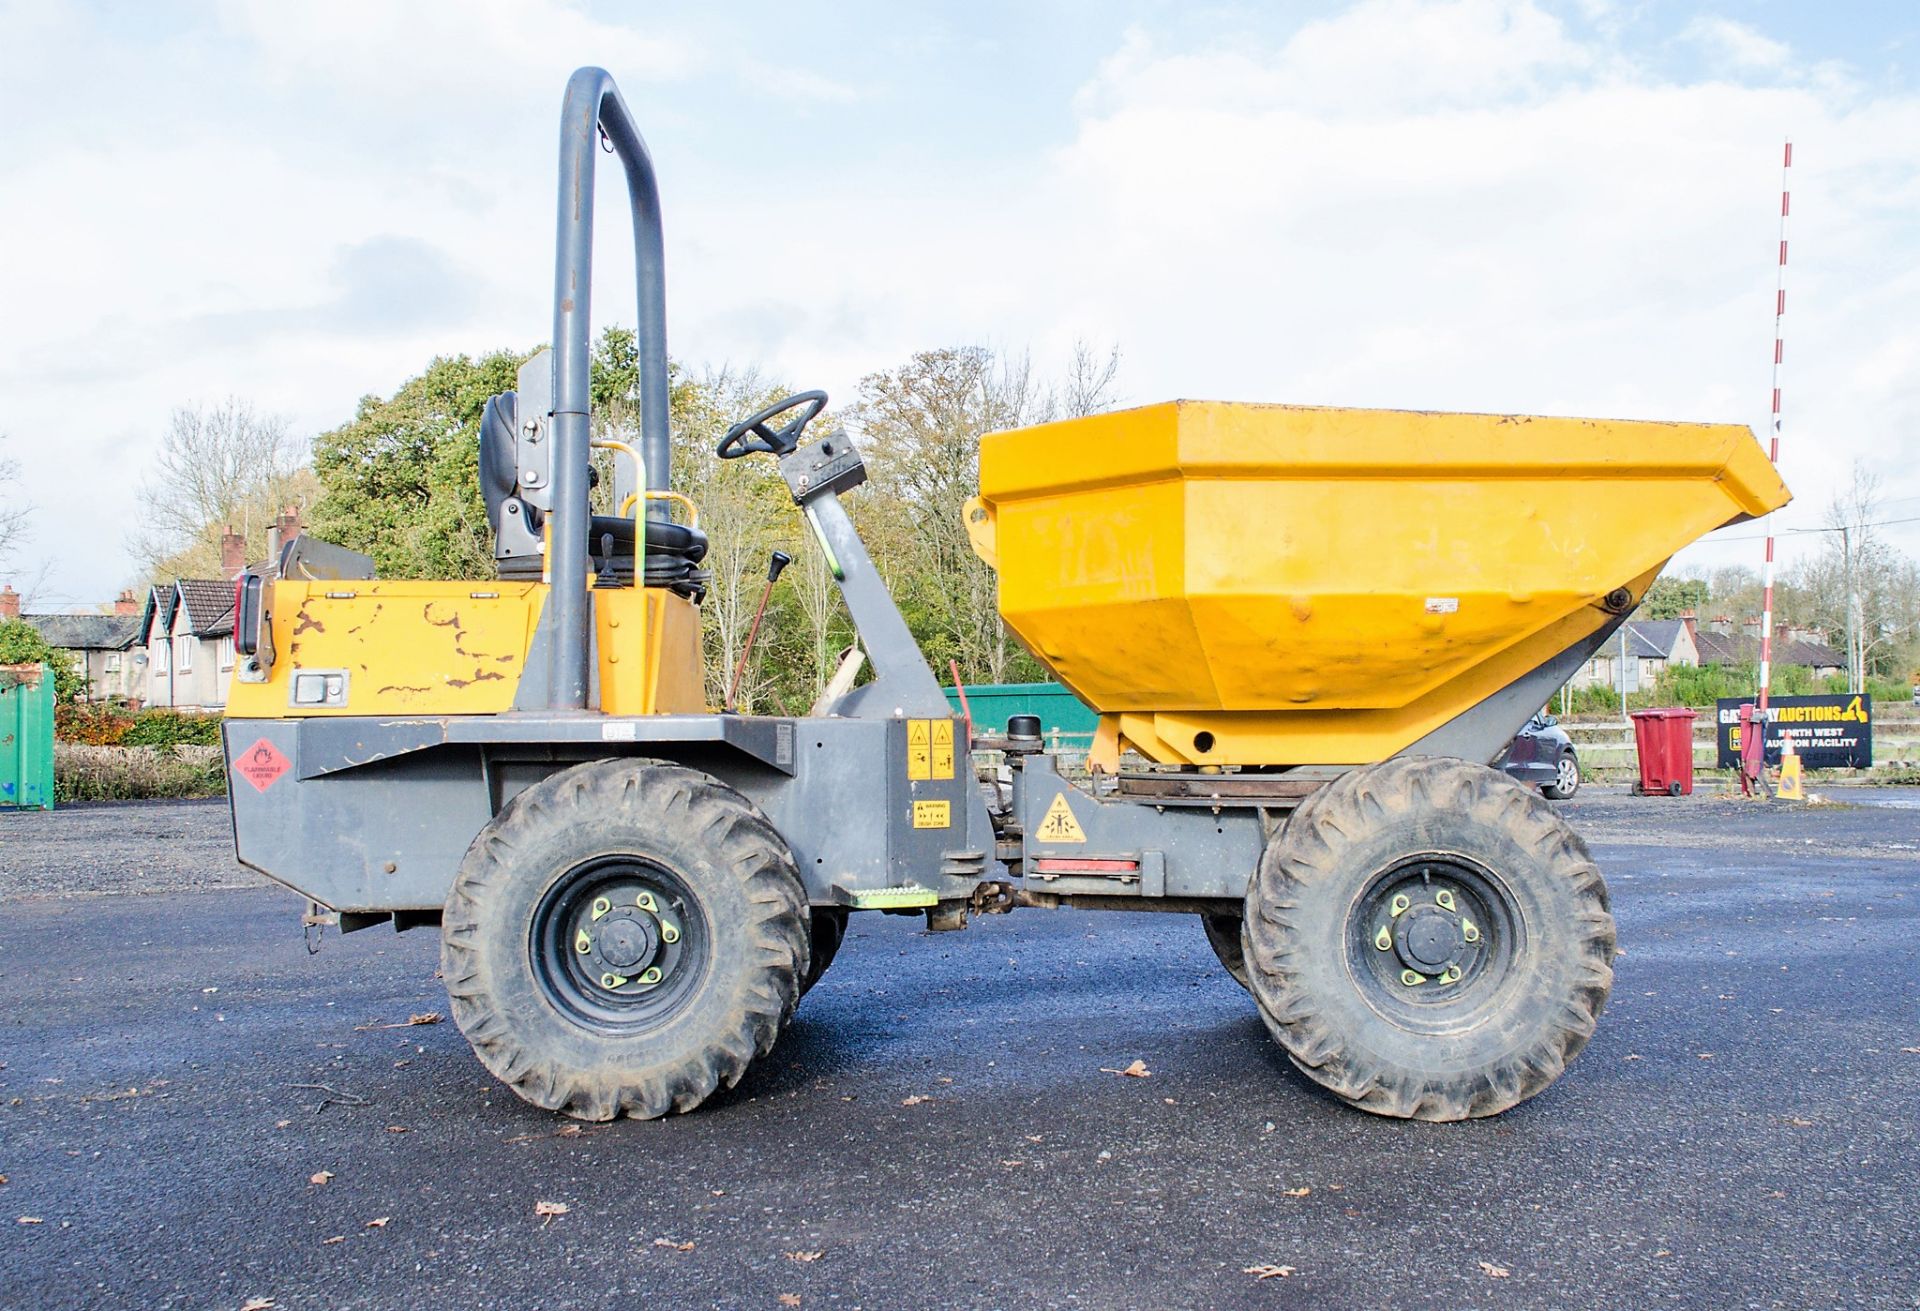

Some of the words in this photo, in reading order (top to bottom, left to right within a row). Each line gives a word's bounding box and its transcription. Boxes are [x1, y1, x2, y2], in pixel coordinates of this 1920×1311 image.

[1778, 705, 1842, 722] AUCTIONS
[1778, 728, 1813, 737] NORTH
[1813, 727, 1844, 737] WEST
[1766, 739, 1810, 748] AUCION
[1811, 738, 1857, 748] FACILITY
